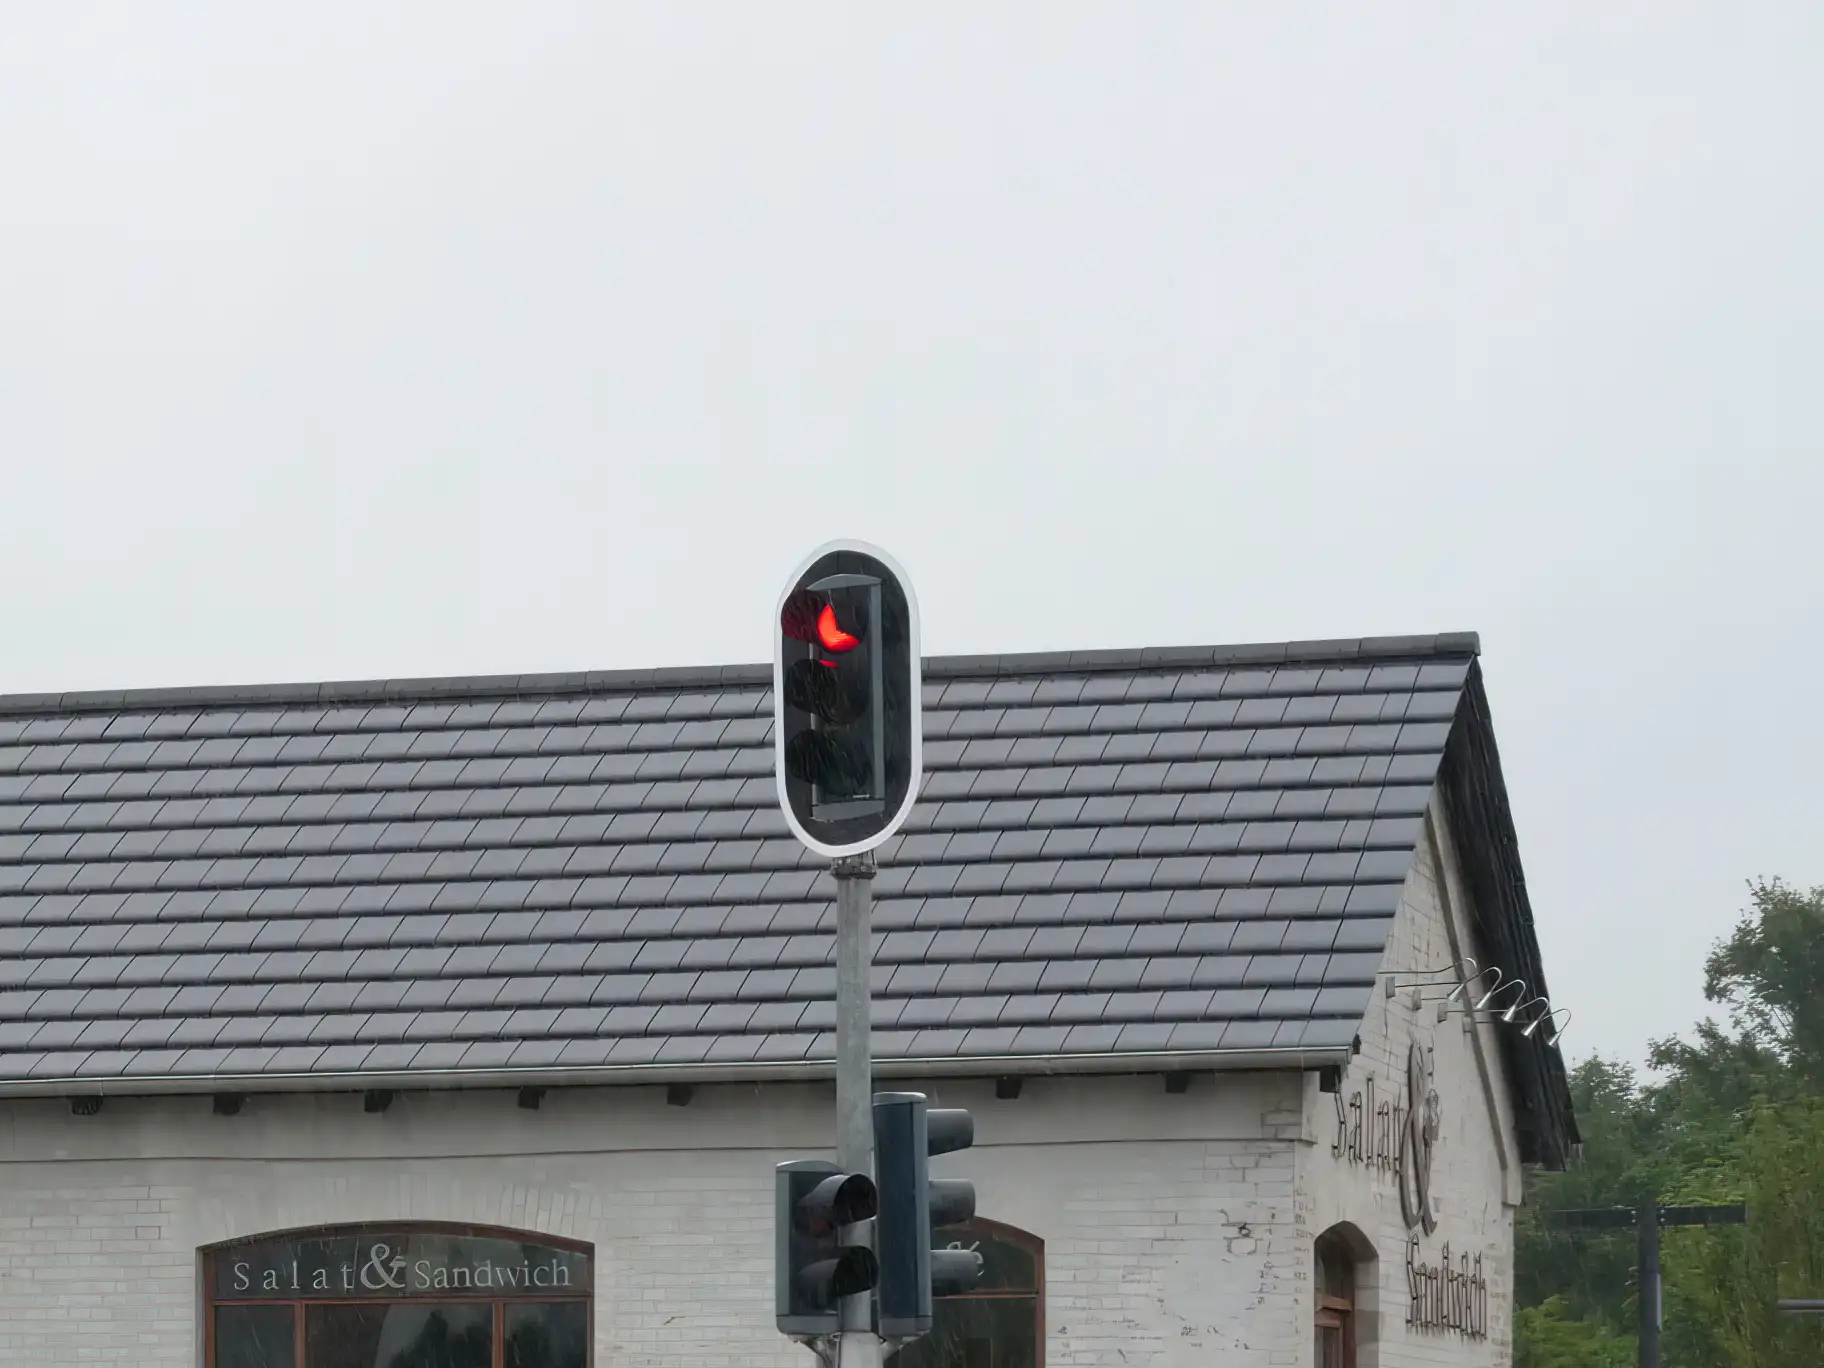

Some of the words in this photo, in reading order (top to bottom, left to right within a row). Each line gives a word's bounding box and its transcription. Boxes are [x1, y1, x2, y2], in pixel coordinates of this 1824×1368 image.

[233, 1259, 355, 1291] Salat
[360, 1243, 407, 1290] &
[414, 1258, 573, 1290] Sandwich
